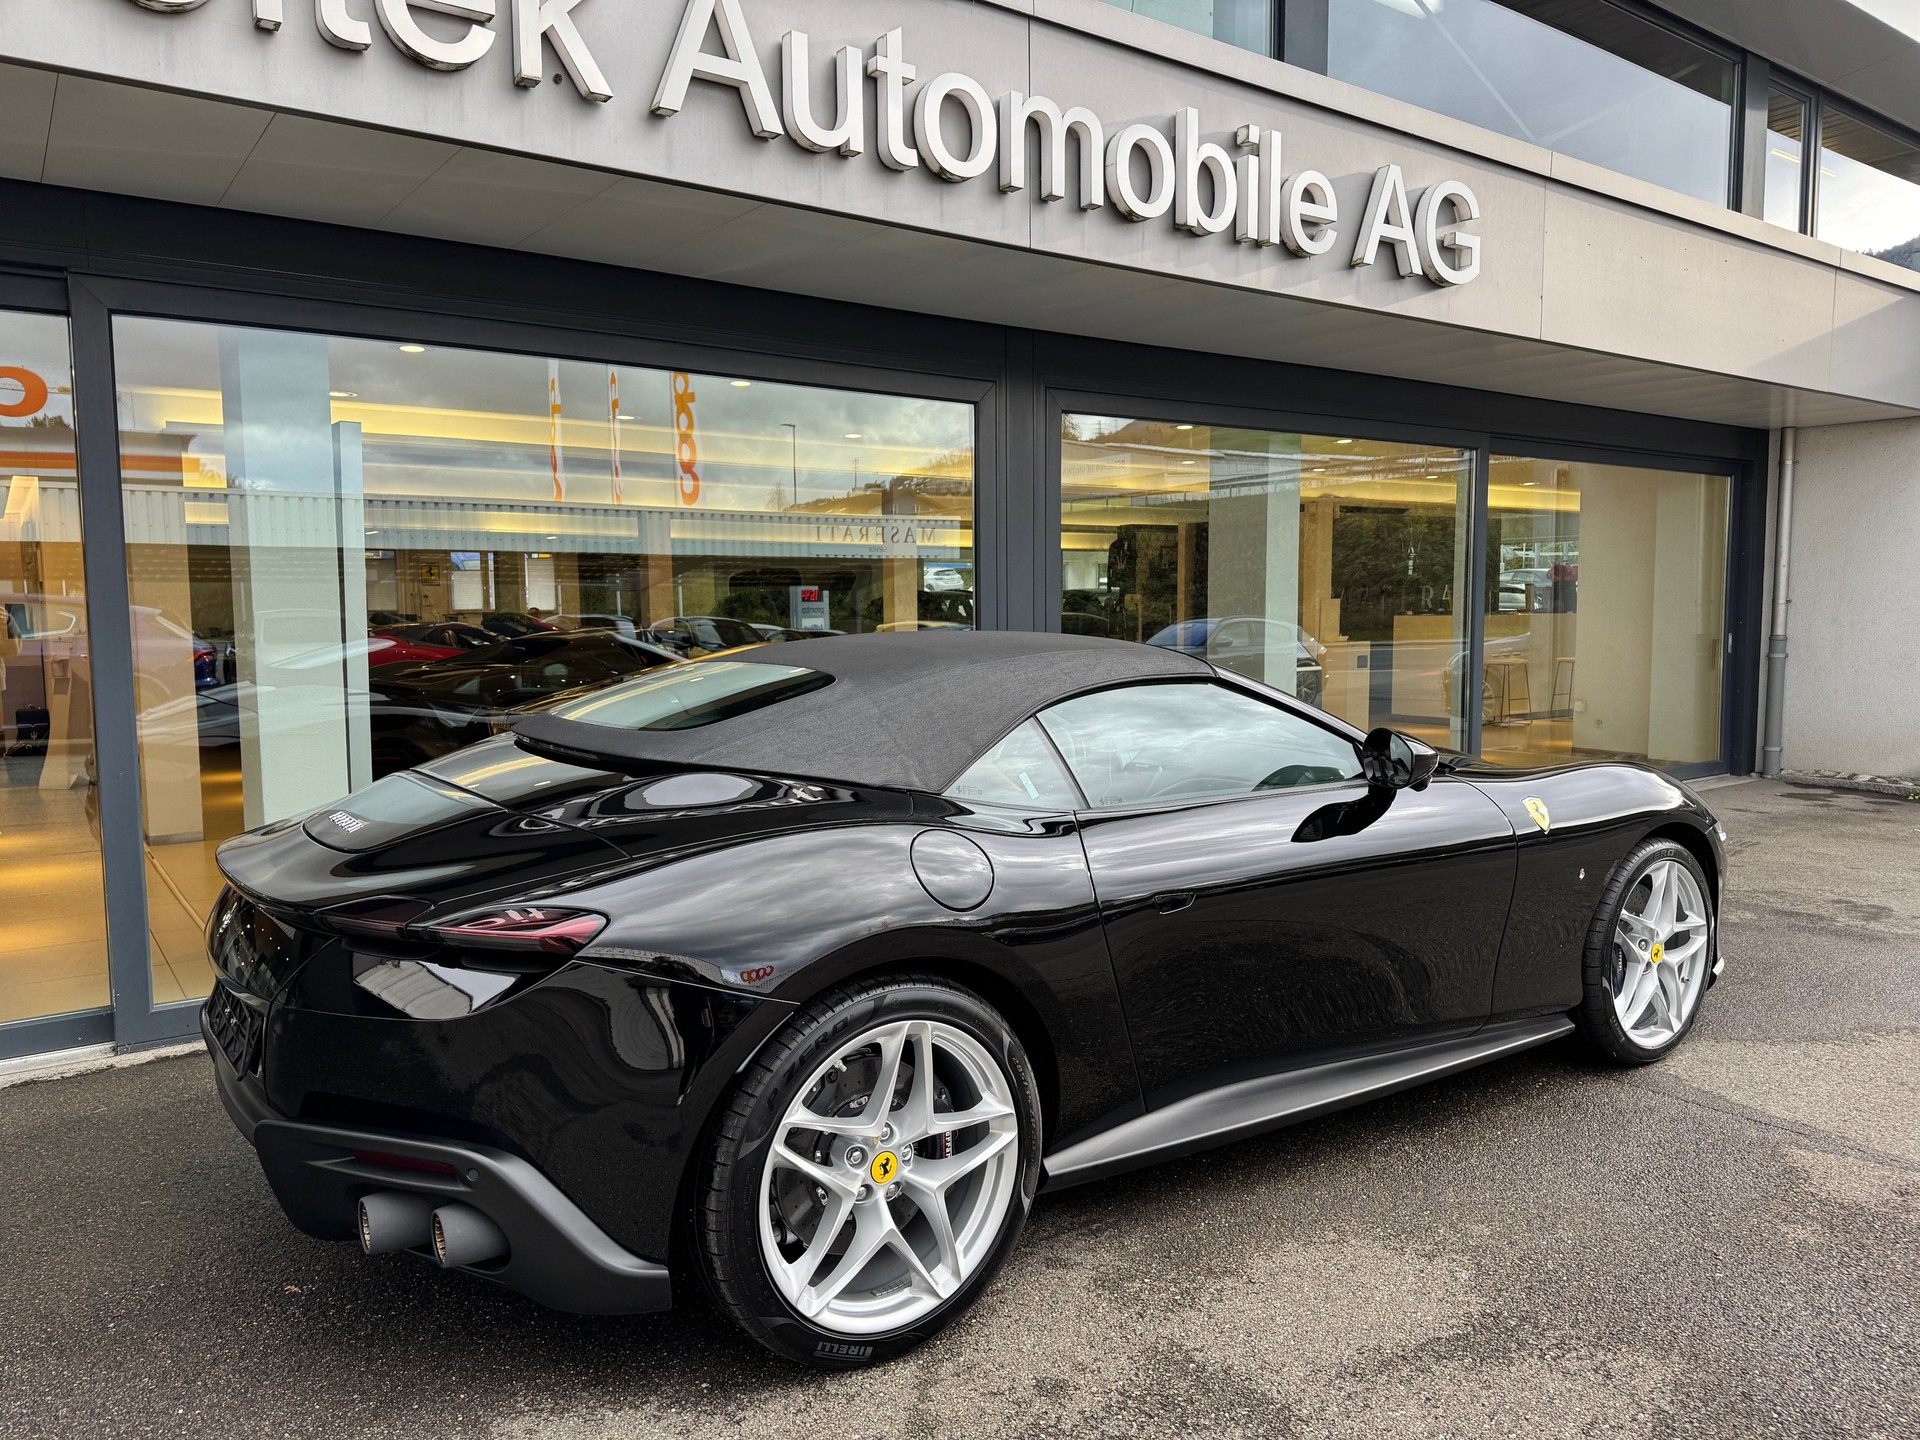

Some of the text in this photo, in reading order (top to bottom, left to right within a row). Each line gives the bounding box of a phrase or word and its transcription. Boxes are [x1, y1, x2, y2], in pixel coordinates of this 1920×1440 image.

[650, 0, 1338, 258] Automobile
[1351, 163, 1481, 288] AG
[783, 1016, 849, 1086] ZERO
[813, 1341, 873, 1361] PIRELLI
